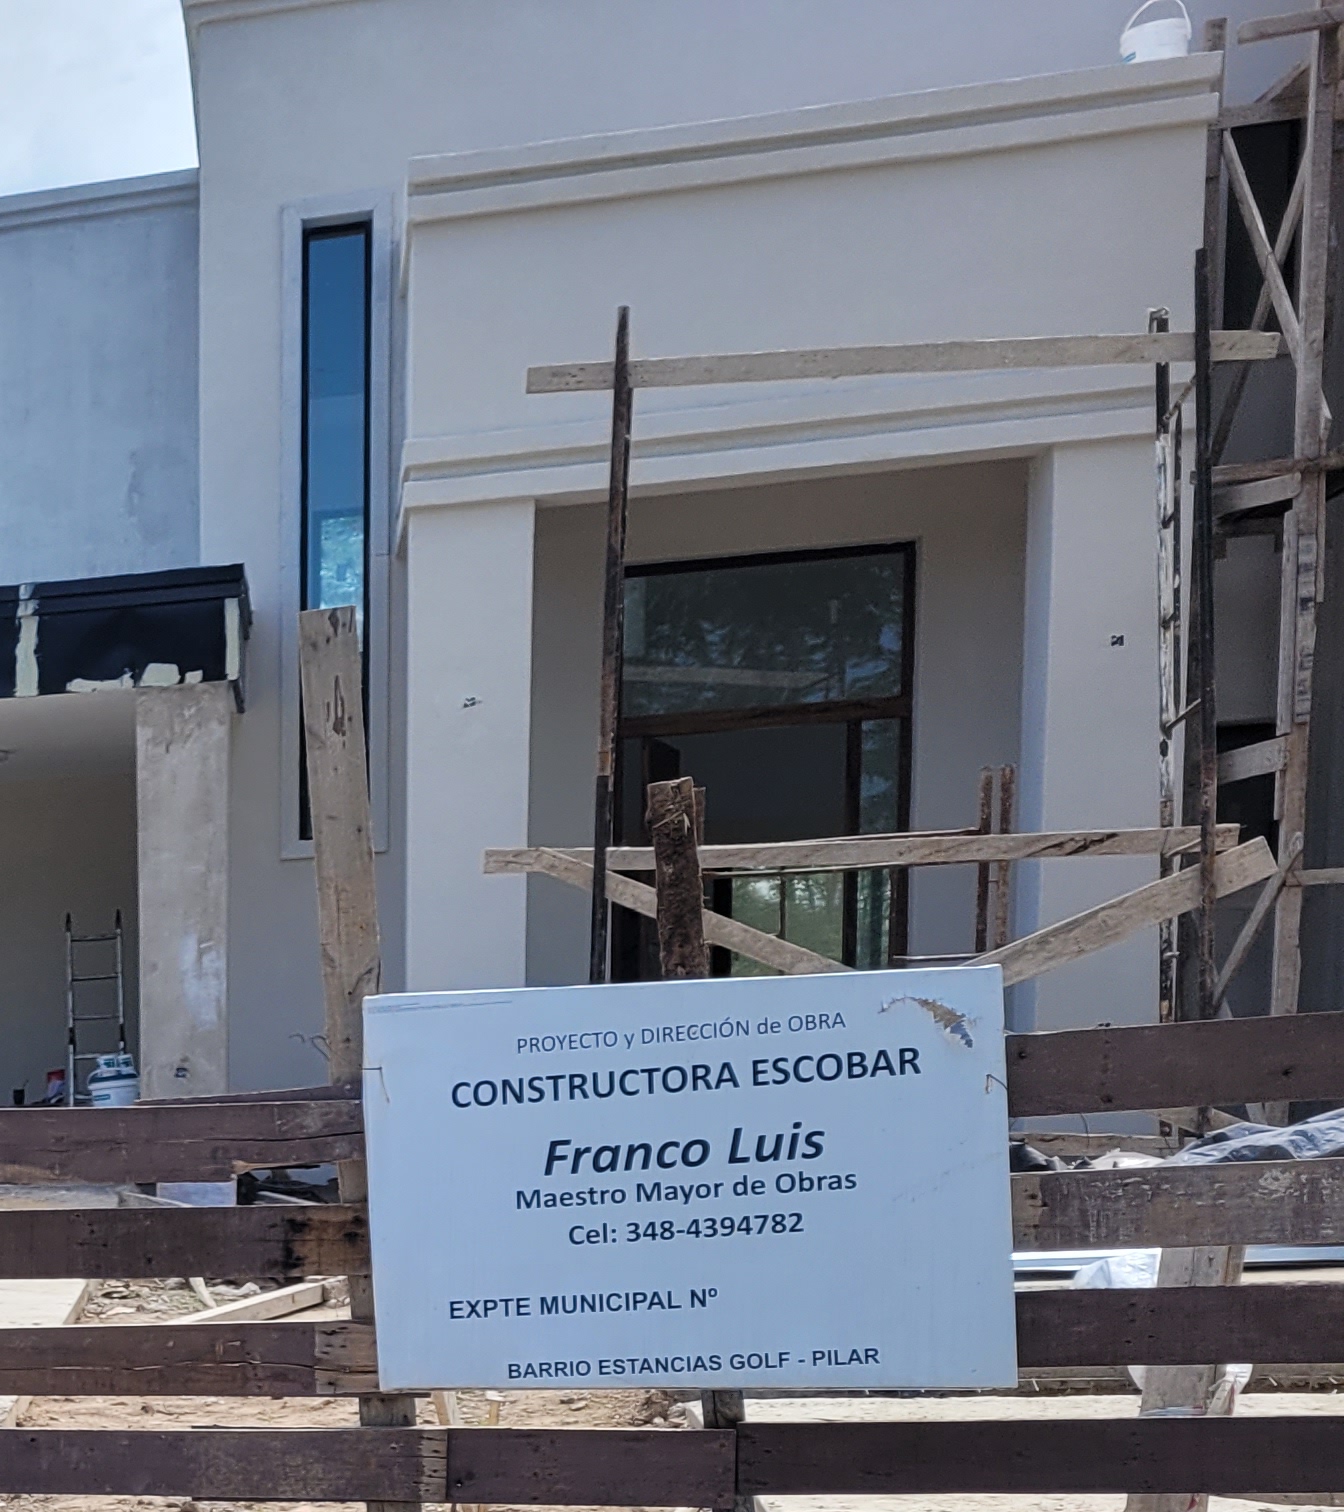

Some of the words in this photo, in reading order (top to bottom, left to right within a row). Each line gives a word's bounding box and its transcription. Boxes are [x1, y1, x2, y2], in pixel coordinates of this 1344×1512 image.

[517, 1030, 618, 1056] PROYECTO
[623, 1032, 635, 1050] y
[641, 1016, 750, 1045] DIRECCIÓN
[756, 1016, 782, 1035] de
[787, 1011, 847, 1033] OBRA
[451, 1061, 741, 1109] CONSTRUCTORA
[751, 1046, 922, 1087] ESCOBAR
[543, 1138, 711, 1177] Franco
[727, 1121, 826, 1165] Luis
[516, 1186, 627, 1210] Maestro
[635, 1181, 725, 1206] Mayor
[732, 1174, 767, 1197] de
[775, 1170, 858, 1194] Obras
[568, 1222, 618, 1246] Cel:
[626, 1212, 805, 1243] 348-4394782
[448, 1297, 532, 1320] EXPTE
[539, 1290, 683, 1316] MUNICIPAL
[507, 1360, 592, 1380] BARRIO
[598, 1354, 723, 1376] ESTANCIAS
[729, 1351, 791, 1371] GOLF
[811, 1347, 881, 1367] PILAR
